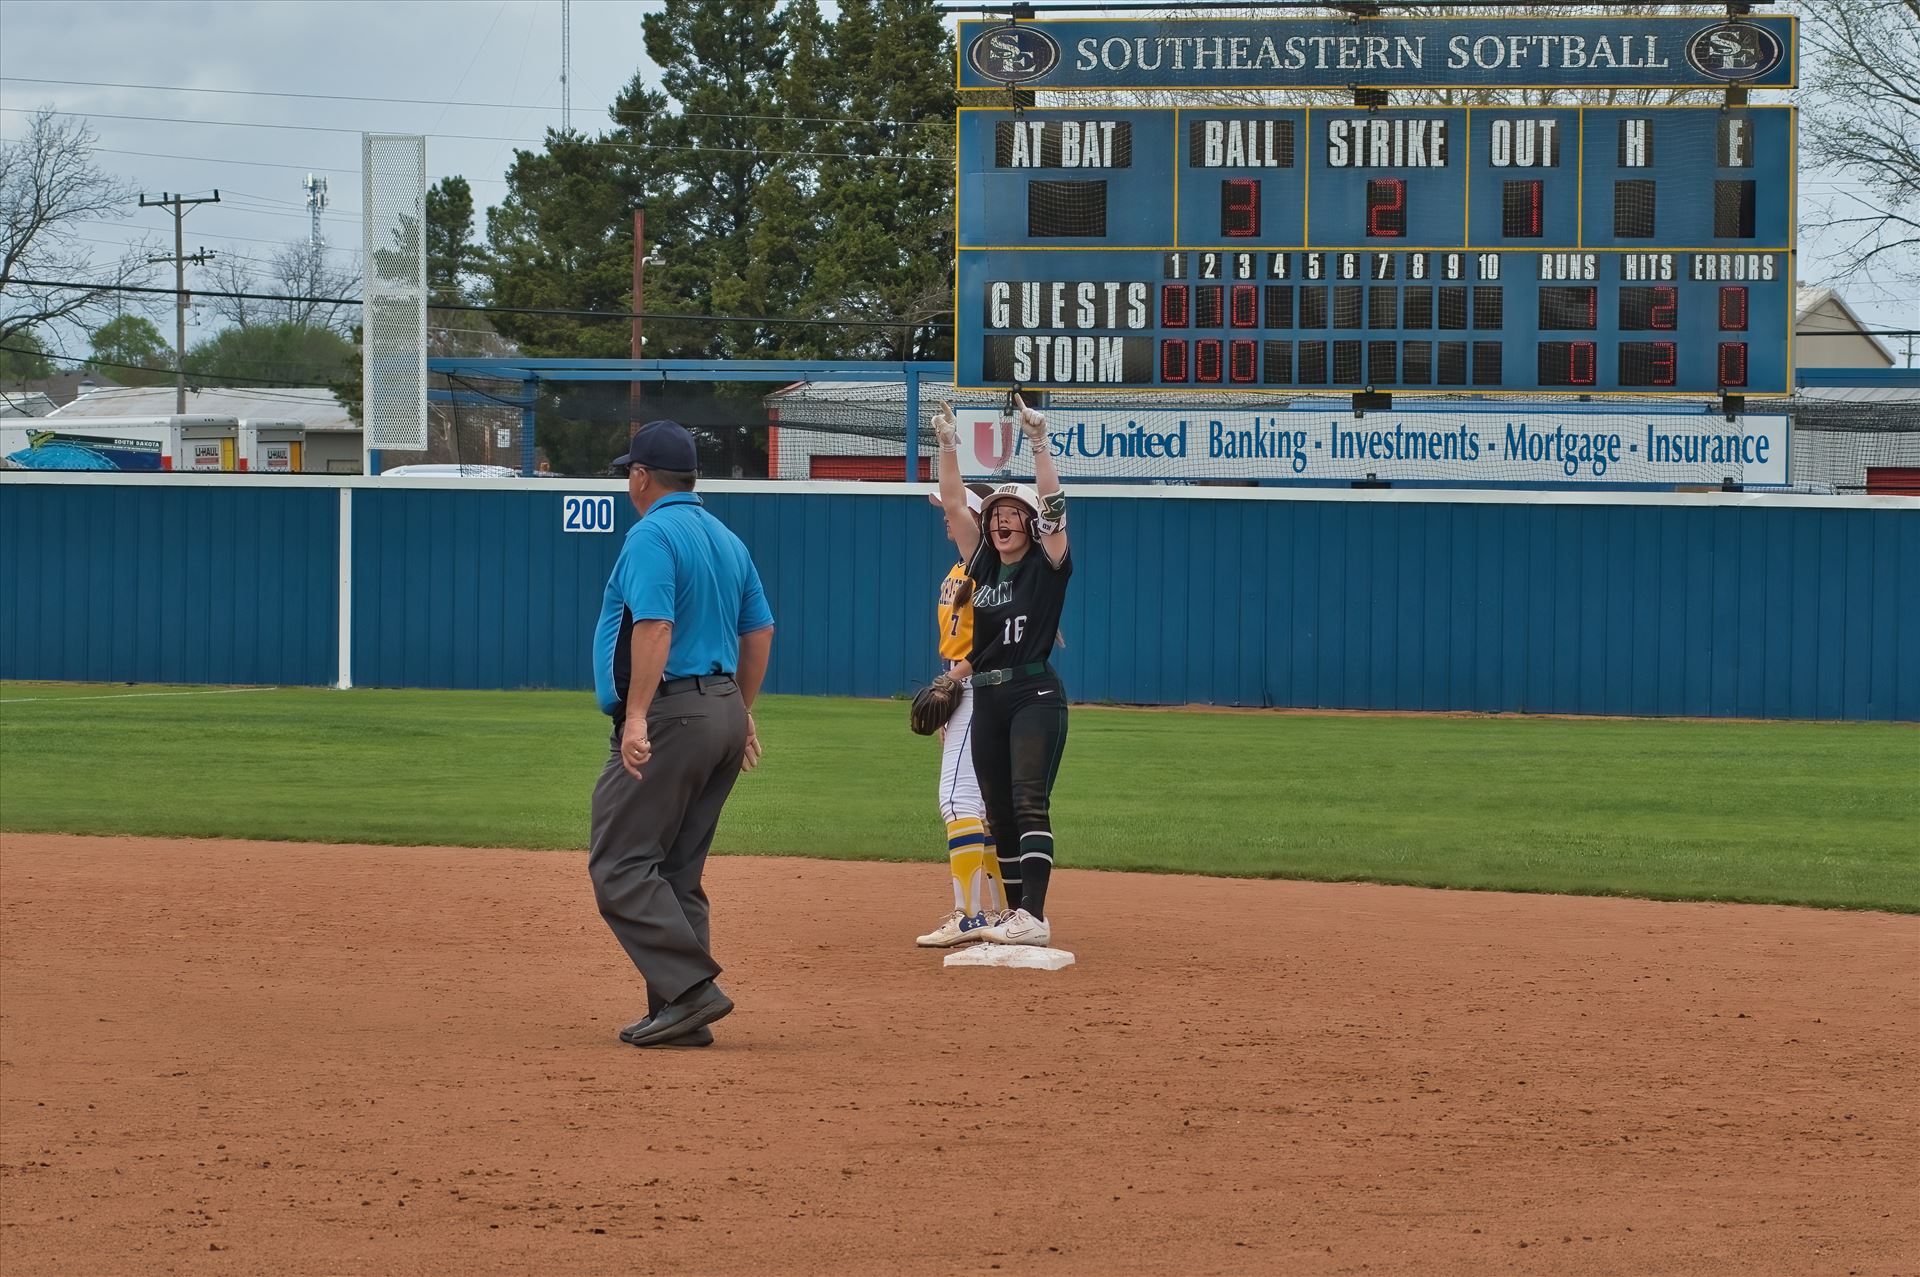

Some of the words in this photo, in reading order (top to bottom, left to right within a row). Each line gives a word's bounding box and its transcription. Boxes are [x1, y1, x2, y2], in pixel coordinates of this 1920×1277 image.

[1076, 36, 1427, 72] SOUTHEASTERN
[1447, 35, 1669, 70] SOFTBALL
[1011, 121, 1044, 168] AT
[1061, 121, 1116, 168] BAT
[1204, 120, 1278, 167] BALL
[1329, 119, 1445, 167] STRIKE
[1491, 119, 1556, 167] OUT
[1625, 119, 1645, 167] H
[1728, 119, 1743, 167] E
[1228, 178, 1257, 238] 3
[1371, 178, 1402, 238] 2
[1530, 180, 1540, 235] 1
[1171, 253, 1180, 279] 1
[1204, 253, 1216, 279] 2
[1239, 253, 1250, 279] 3
[1273, 253, 1285, 279] 4
[1308, 253, 1320, 280] 5
[1343, 253, 1354, 279] 6
[1378, 253, 1389, 279] 7
[1412, 253, 1424, 280] 8
[1447, 253, 1459, 280] 9
[1478, 253, 1499, 280] 10
[1541, 253, 1596, 280] RUNS
[1625, 254, 1672, 280] HITS
[1694, 254, 1774, 281] ERRORS
[990, 281, 1147, 329] GUESTS
[1163, 285, 1187, 326] 0
[1232, 284, 1256, 326] 0
[1651, 285, 1676, 328] 2
[1720, 286, 1746, 329] 0
[1013, 336, 1124, 383] STORM
[1163, 339, 1187, 381] 0
[1197, 339, 1221, 381] 0
[1231, 339, 1255, 381] 0
[1569, 341, 1595, 383] 0
[1652, 342, 1675, 384] 3
[1719, 342, 1746, 385] 0
[1015, 420, 1187, 458] FstUnited
[1209, 416, 1307, 474] Banking
[1331, 421, 1480, 461] Investments
[1503, 422, 1621, 477] Mortgage
[1647, 423, 1770, 463] Insurance
[566, 498, 612, 530] 200
[951, 613, 960, 637] 7
[1003, 615, 1028, 646] 16
